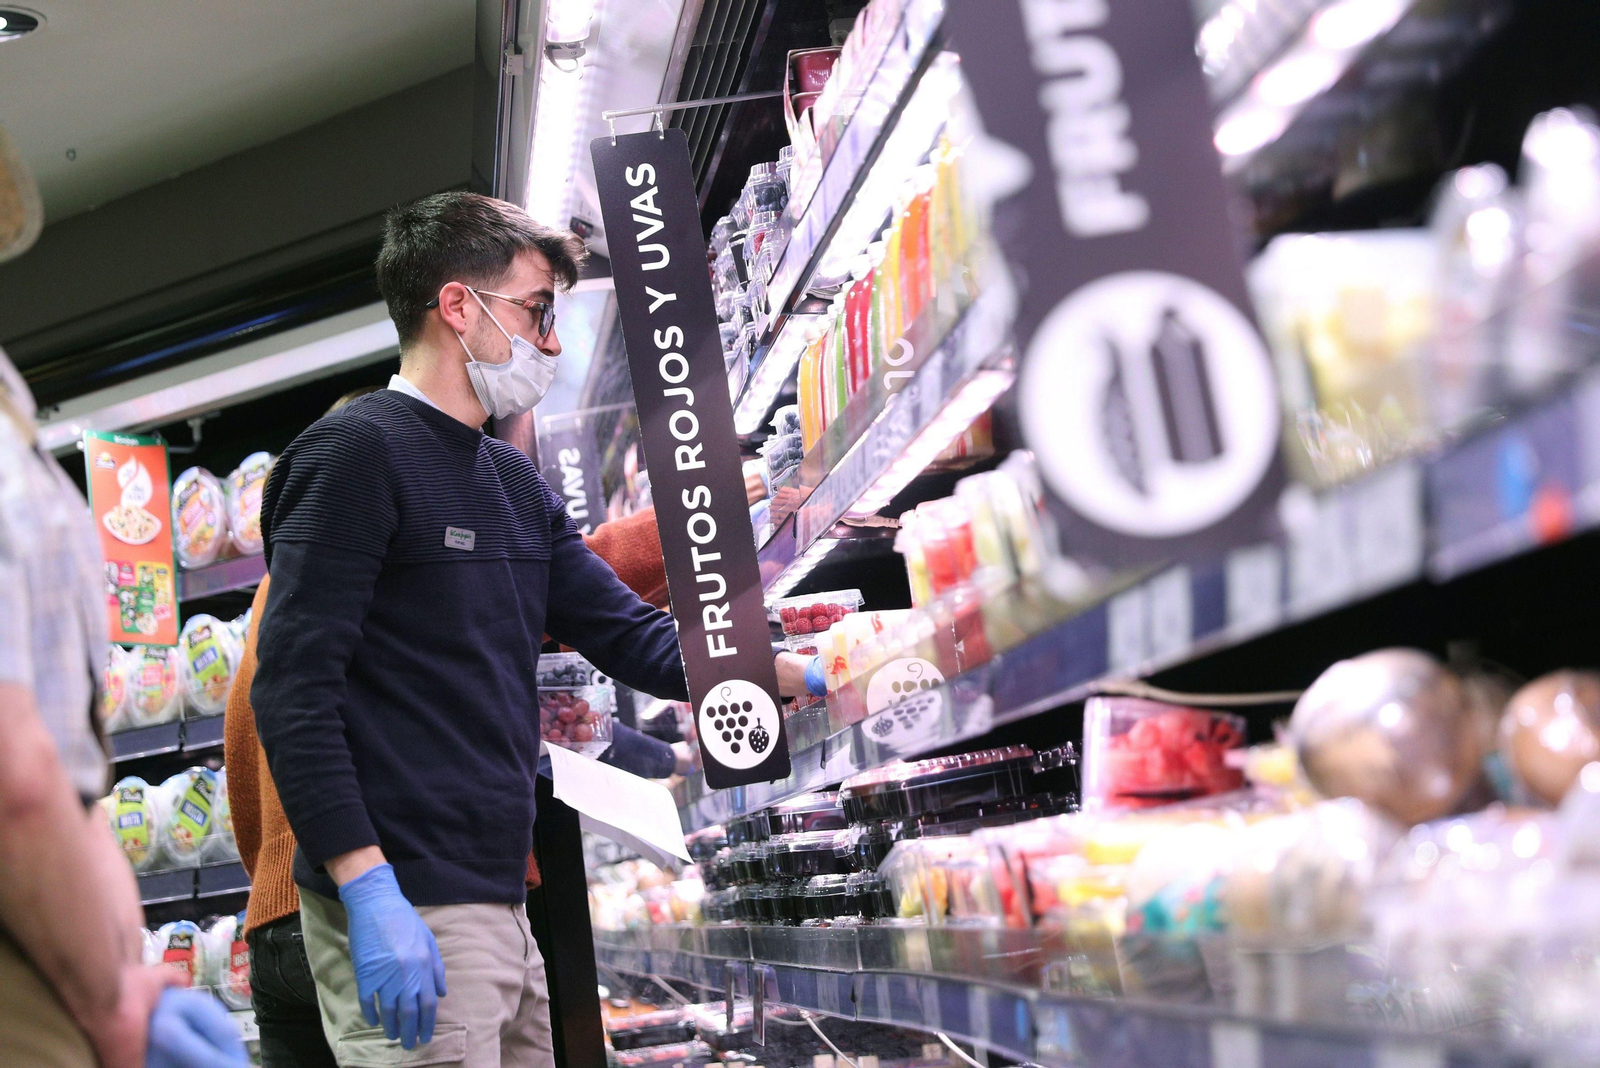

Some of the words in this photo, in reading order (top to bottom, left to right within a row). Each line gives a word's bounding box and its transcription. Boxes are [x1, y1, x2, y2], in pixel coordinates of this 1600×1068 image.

[625, 163, 671, 271] UVAS
[645, 286, 677, 314] Y
[654, 325, 706, 471] ROJOS
[682, 485, 738, 658] FRUTOS
